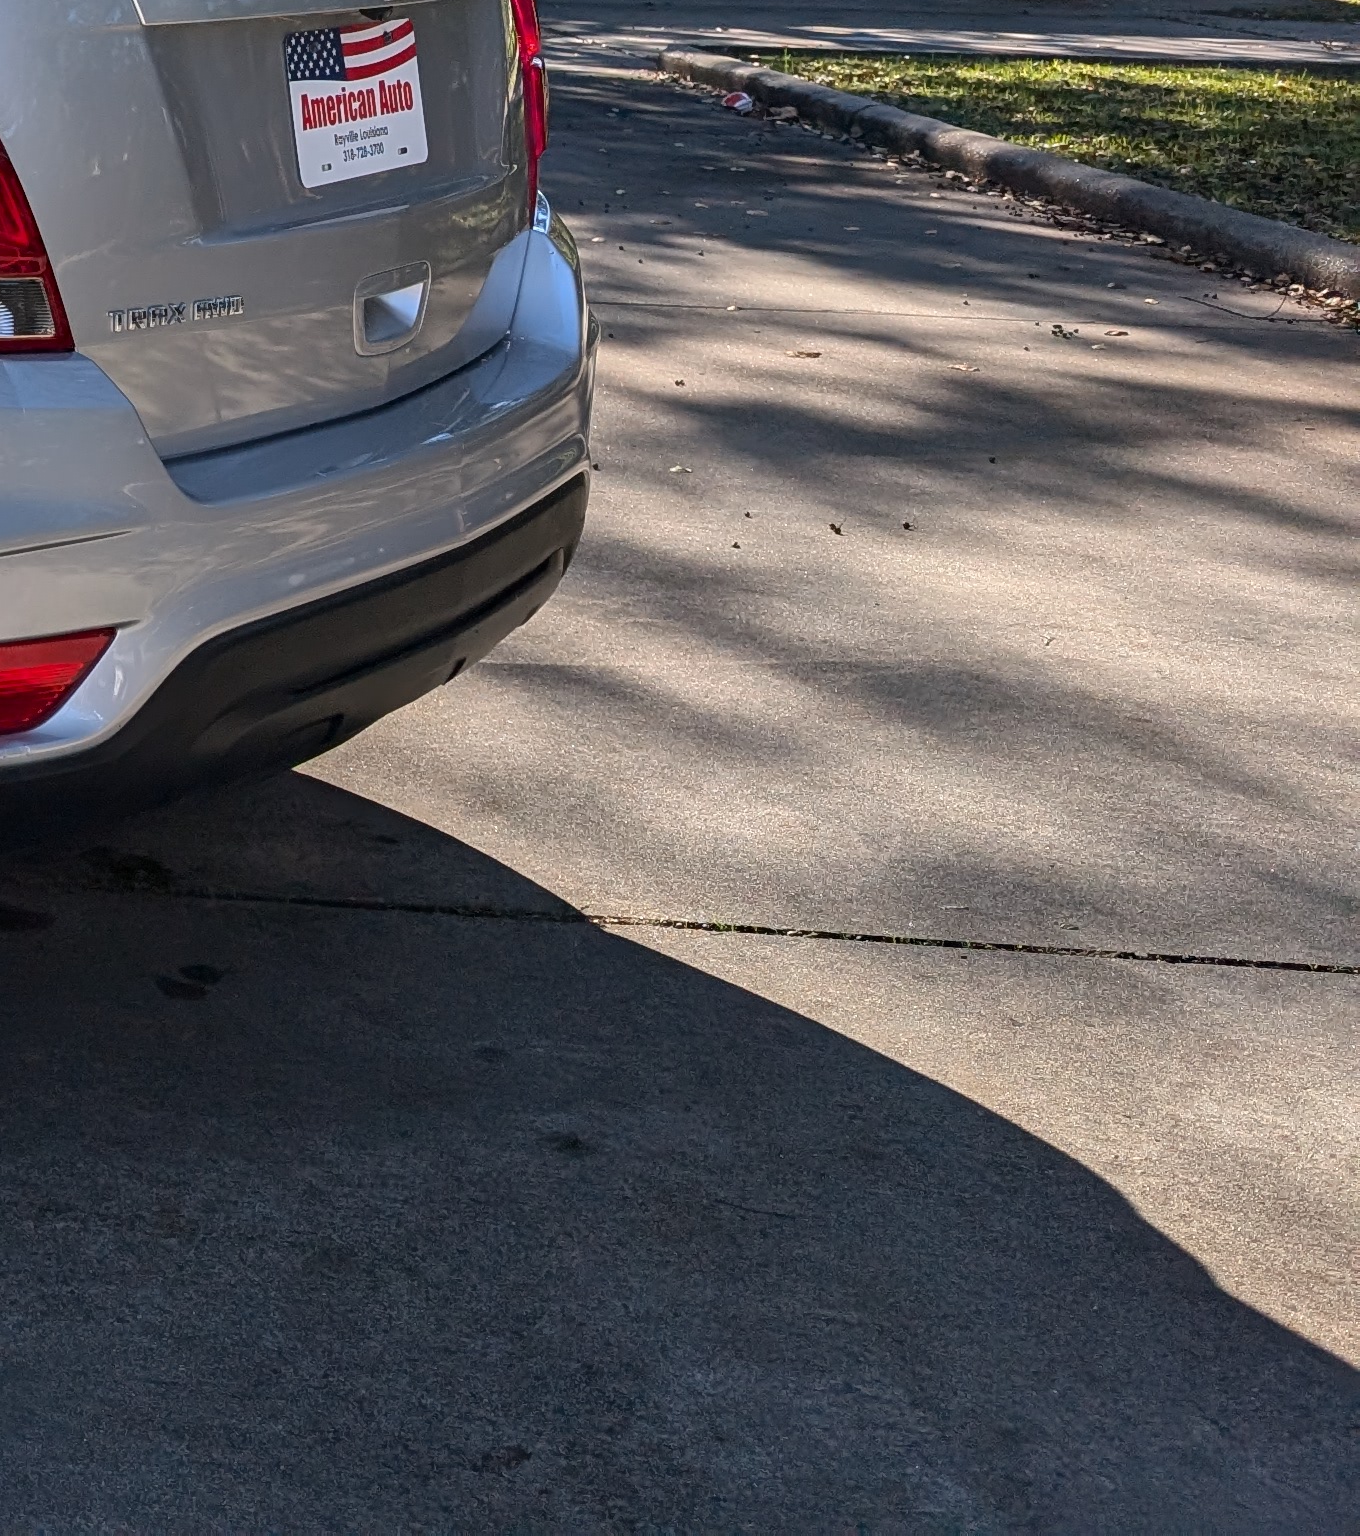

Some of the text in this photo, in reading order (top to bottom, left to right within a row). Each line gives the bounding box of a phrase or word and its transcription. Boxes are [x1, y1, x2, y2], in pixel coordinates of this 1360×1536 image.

[301, 79, 414, 131] American Auto
[333, 125, 389, 147] Rayville Louisiana
[106, 294, 244, 333] TRAX AWD
